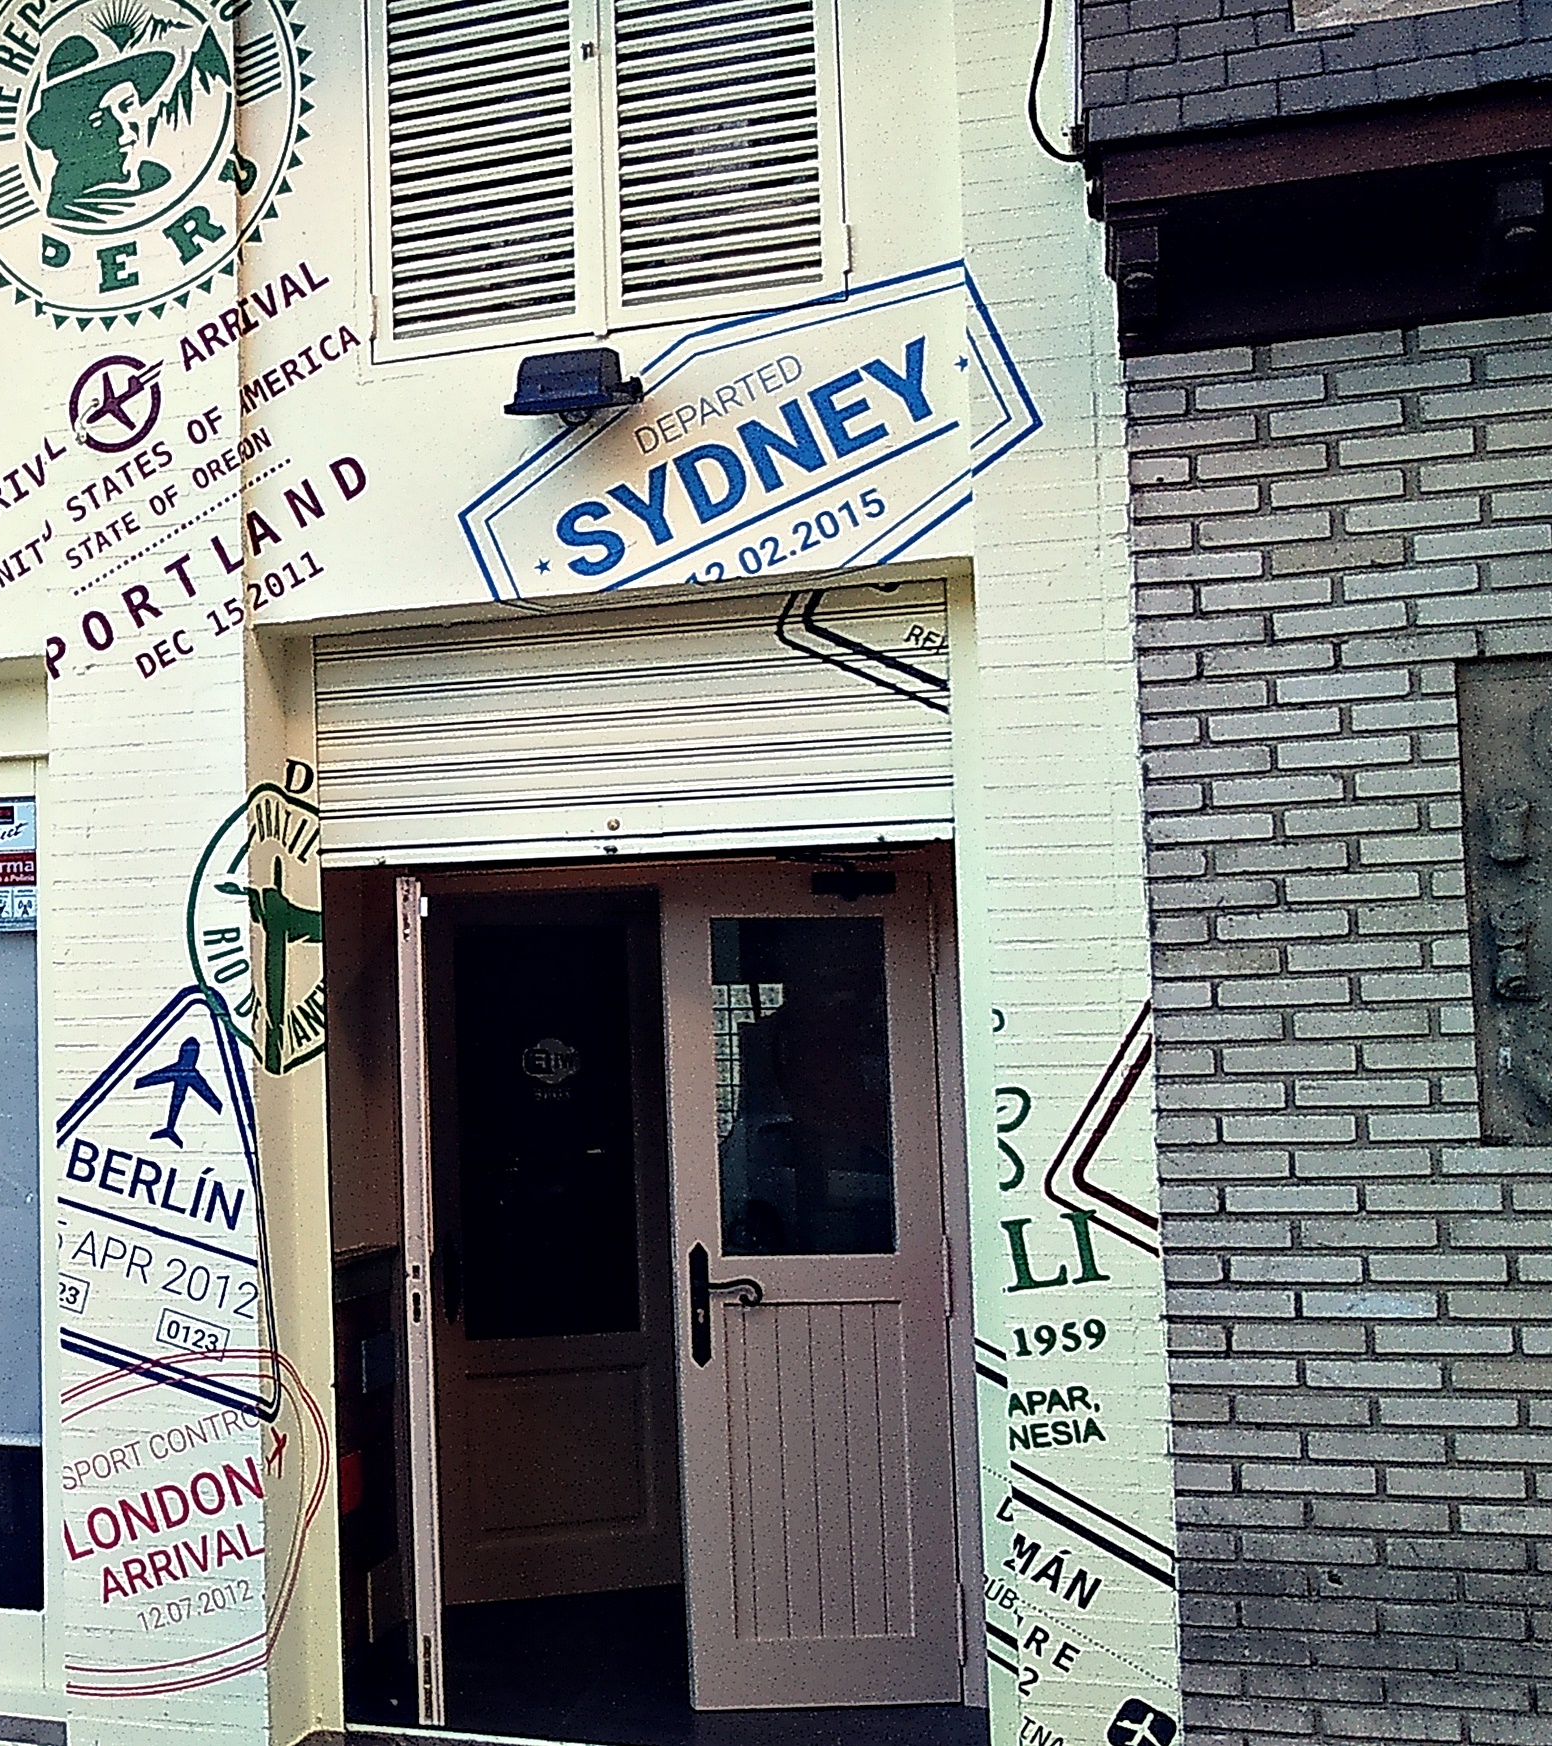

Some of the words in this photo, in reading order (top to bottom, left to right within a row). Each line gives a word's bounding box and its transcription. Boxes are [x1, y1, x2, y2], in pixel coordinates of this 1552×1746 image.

[179, 261, 329, 371] ARRIVAL
[634, 354, 803, 455] DEPARTED
[66, 441, 173, 522] STATES
[187, 405, 223, 445] OF
[555, 335, 934, 577] SYDNEY
[47, 456, 367, 680] PORTLAND
[65, 511, 142, 570] STATE
[149, 485, 179, 517] OF
[135, 630, 195, 680] DEC
[206, 598, 245, 637] 15
[247, 551, 325, 612] 2011
[203, 926, 251, 984] RIO
[66, 1137, 246, 1231] BERLÍN
[71, 1230, 153, 1284] APR
[161, 1257, 259, 1320] 2012
[166, 1320, 219, 1353] 0123
[1012, 1318, 1108, 1358] 1959
[1008, 1416, 1106, 1451] NESIA
[63, 1456, 265, 1561] LONDON
[102, 1523, 266, 1604] ARRIVAL
[137, 1579, 254, 1632] 12.07.2012
